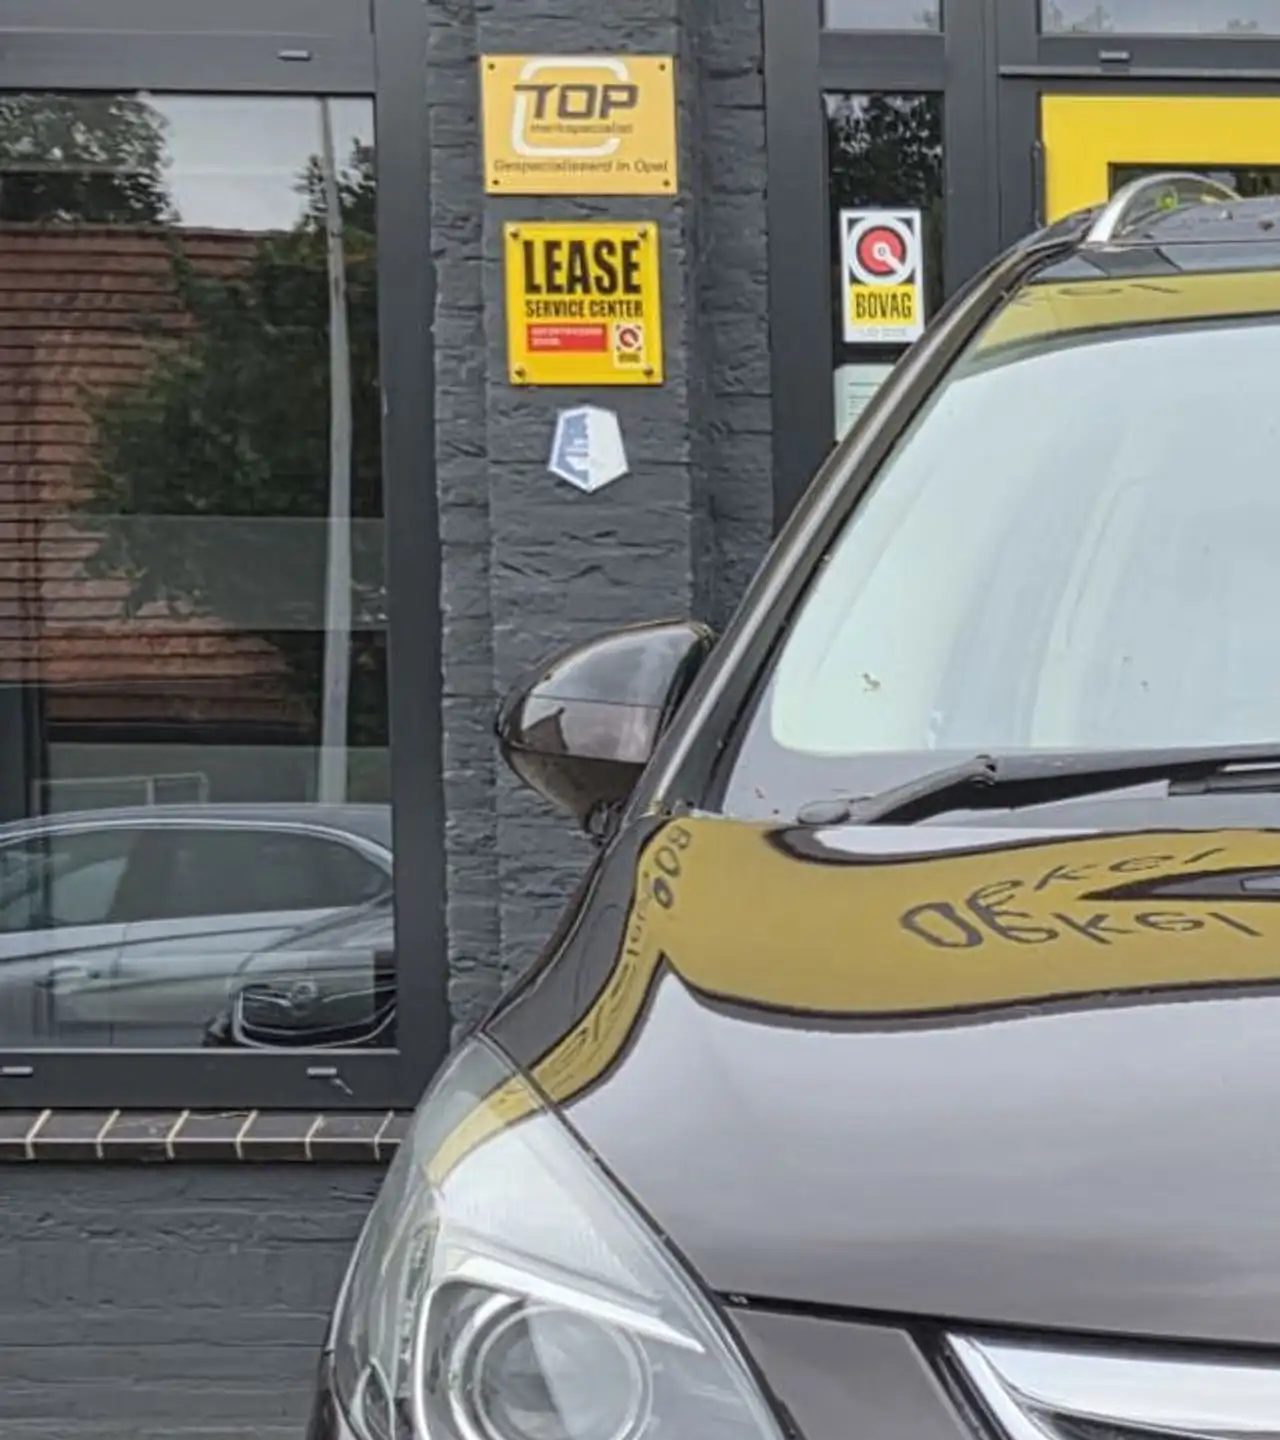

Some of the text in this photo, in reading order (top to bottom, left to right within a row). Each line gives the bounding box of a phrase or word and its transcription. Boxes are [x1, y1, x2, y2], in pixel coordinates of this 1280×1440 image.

[513, 84, 639, 119] TOP
[634, 159, 669, 173] Opel
[523, 239, 642, 294] LEASE
[525, 300, 643, 318] SERVICE CENTER
[855, 292, 912, 319] BOVAG
